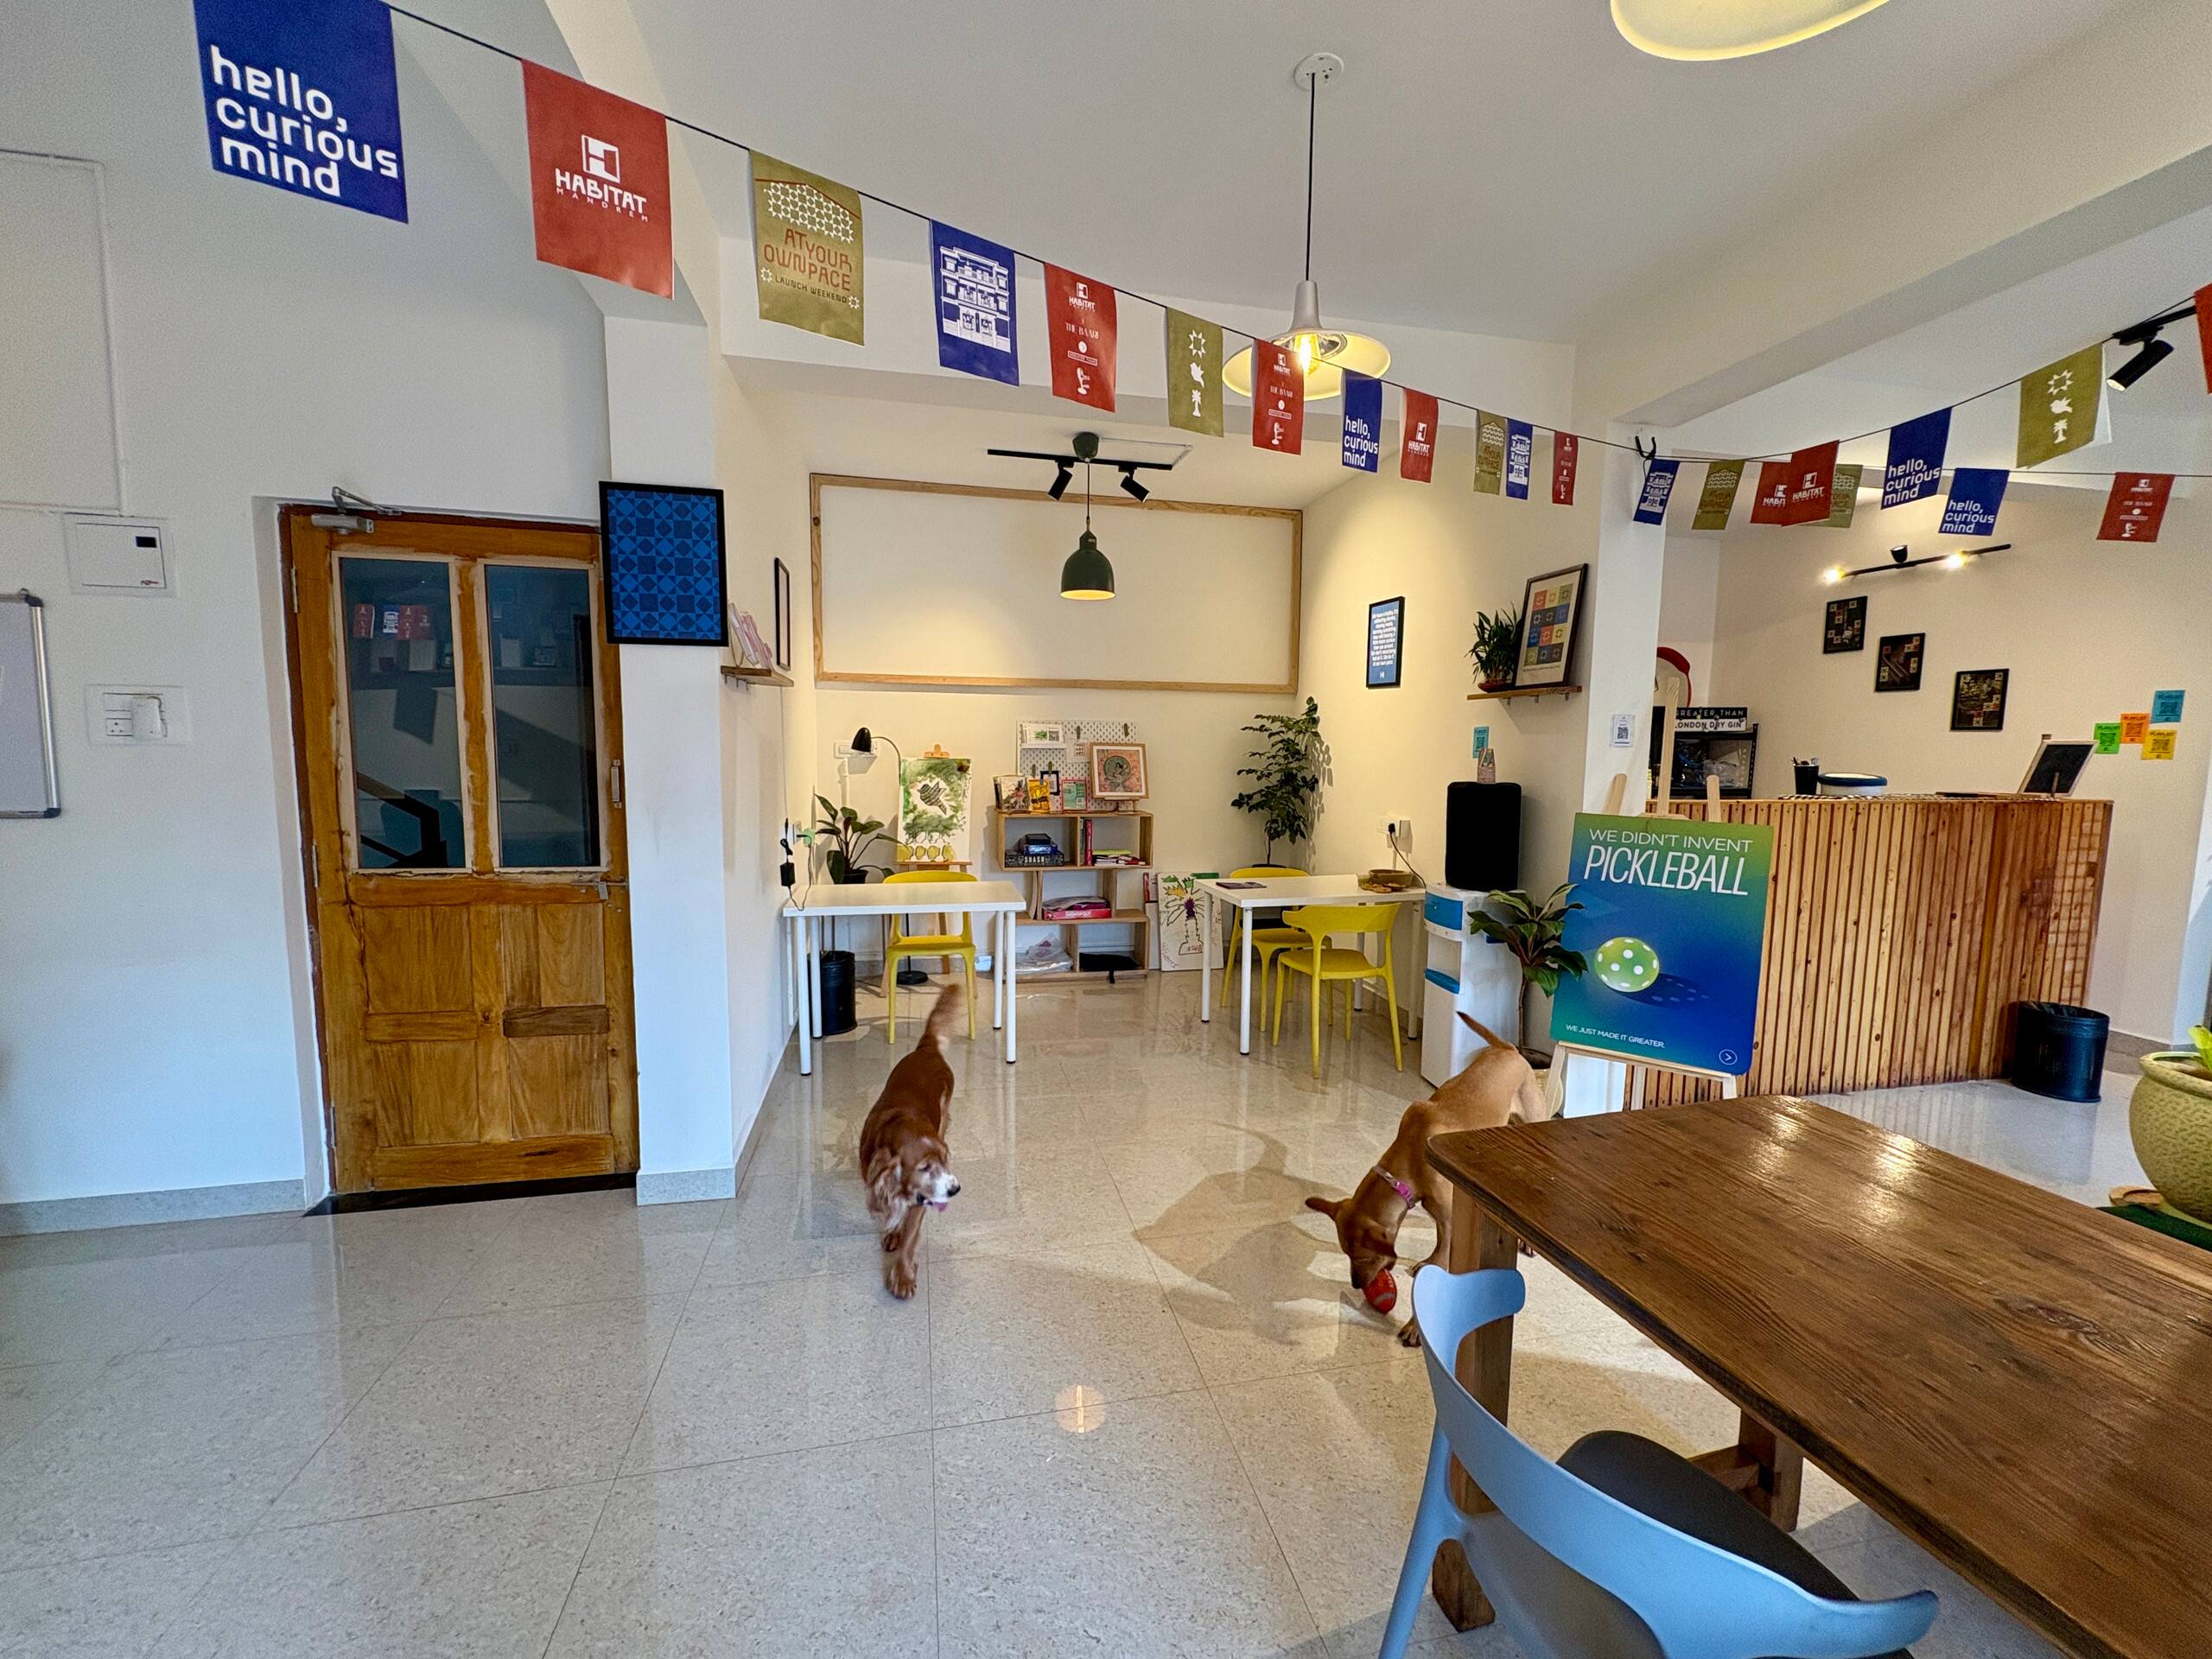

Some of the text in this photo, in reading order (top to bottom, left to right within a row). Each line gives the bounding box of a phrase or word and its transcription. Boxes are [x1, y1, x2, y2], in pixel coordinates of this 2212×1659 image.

[210, 44, 347, 133] hello,
[216, 97, 398, 179] curious
[221, 137, 340, 197] mind
[556, 168, 647, 214] HABITAT
[556, 187, 648, 222] MANDREM
[785, 228, 852, 273] AT YOUR
[764, 244, 851, 291] OWN PACE
[774, 275, 848, 304] LAUNCH WEEKEND
[1069, 296, 1096, 310] HABITAT
[1344, 415, 1370, 440] hello,
[1344, 435, 1379, 455] curious
[1408, 440, 1430, 453] HABITAT
[1343, 449, 1366, 467] mind
[1887, 458, 1928, 479] hello,
[1885, 467, 1942, 492] curious
[1792, 486, 1825, 500] HABITAT
[1883, 484, 1920, 506] mind
[1944, 512, 1995, 524] curious
[1948, 499, 1984, 514] hello,
[1942, 521, 1975, 533] mind
[1589, 829, 1753, 854] WE DIDN'T INVENT
[1583, 844, 1749, 896] PICKLEBALL
[1565, 1024, 1578, 1033] WE
[1597, 1030, 1619, 1040] MADE
